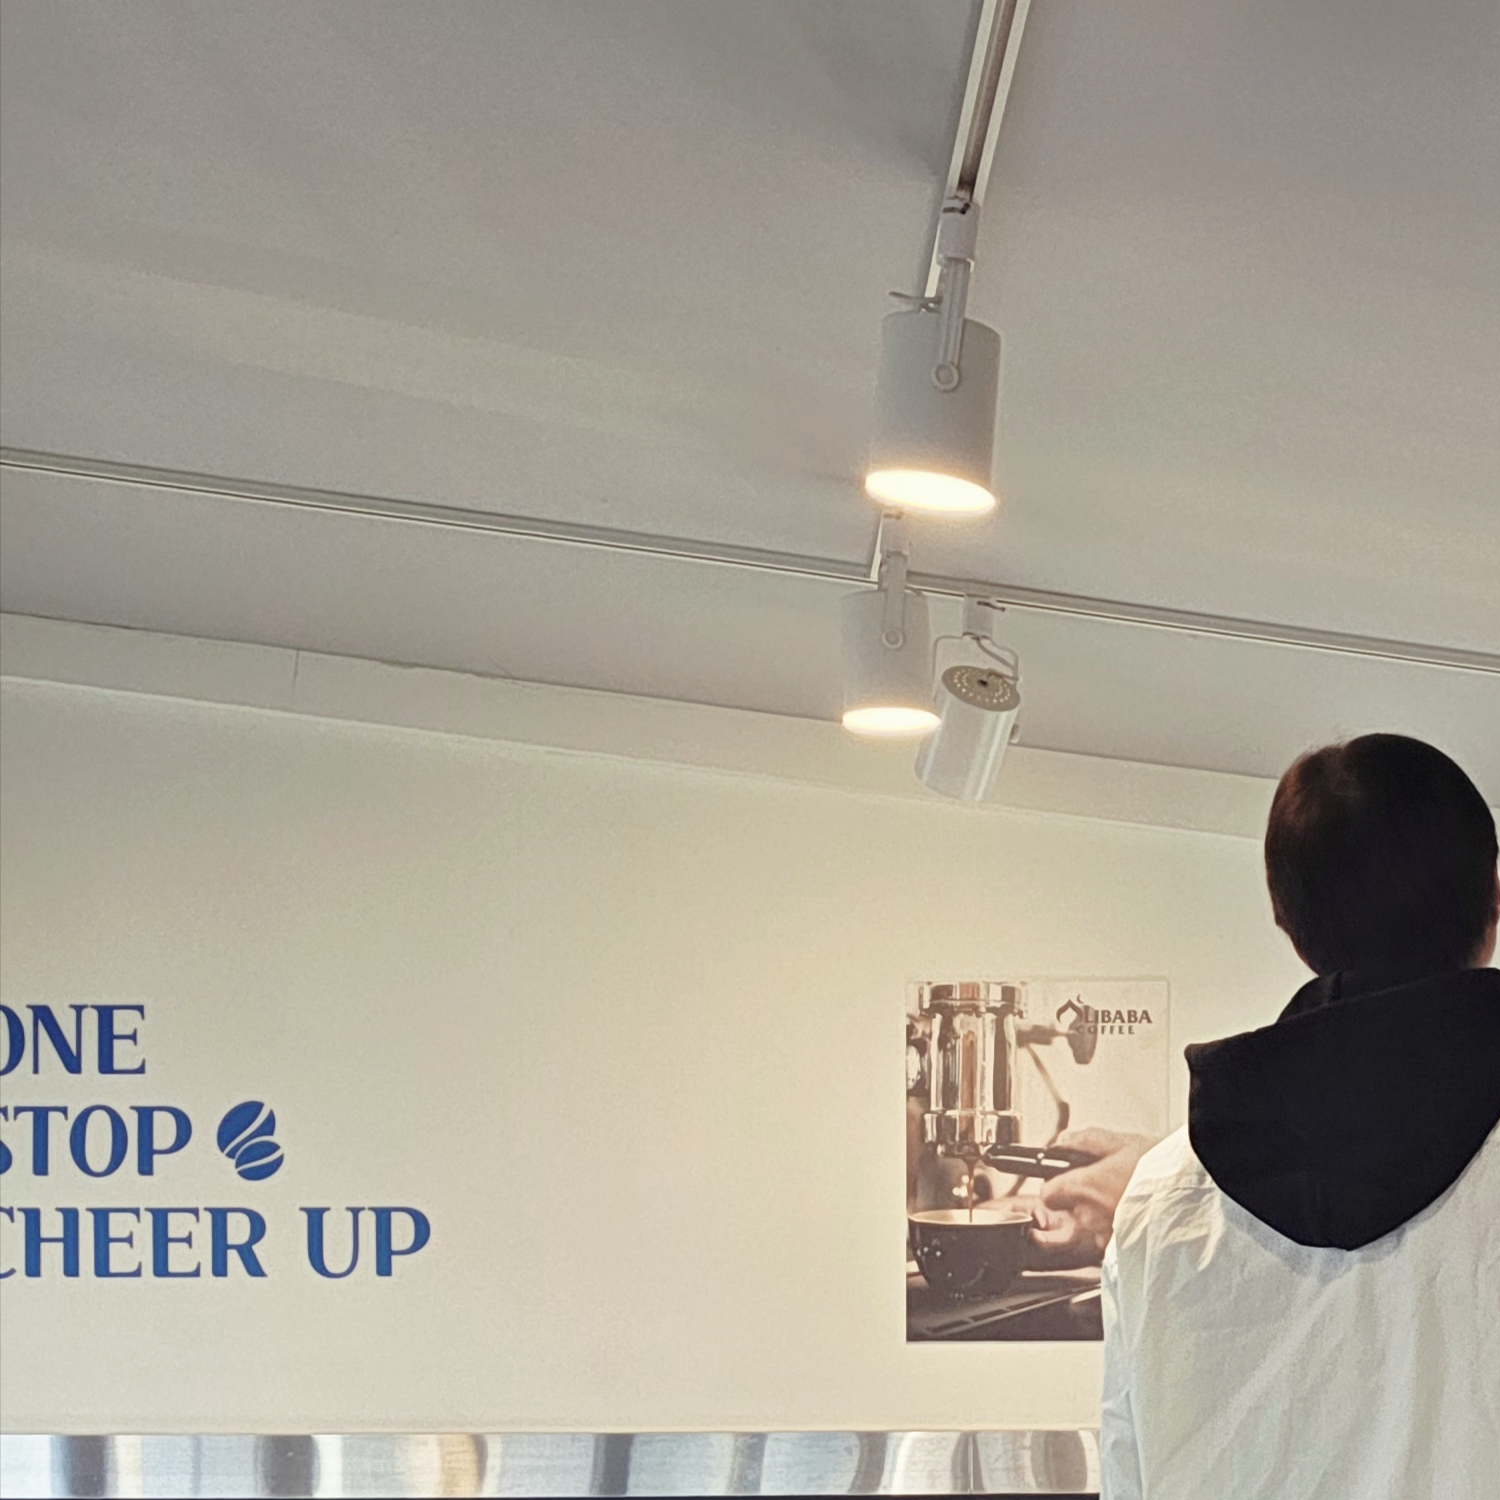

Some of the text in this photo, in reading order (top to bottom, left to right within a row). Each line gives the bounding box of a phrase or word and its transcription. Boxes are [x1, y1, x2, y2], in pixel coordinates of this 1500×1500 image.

[1075, 1025, 1136, 1036] COFFEE
[0, 1104, 192, 1178] TOP
[0, 1206, 432, 1279] HEER UP
